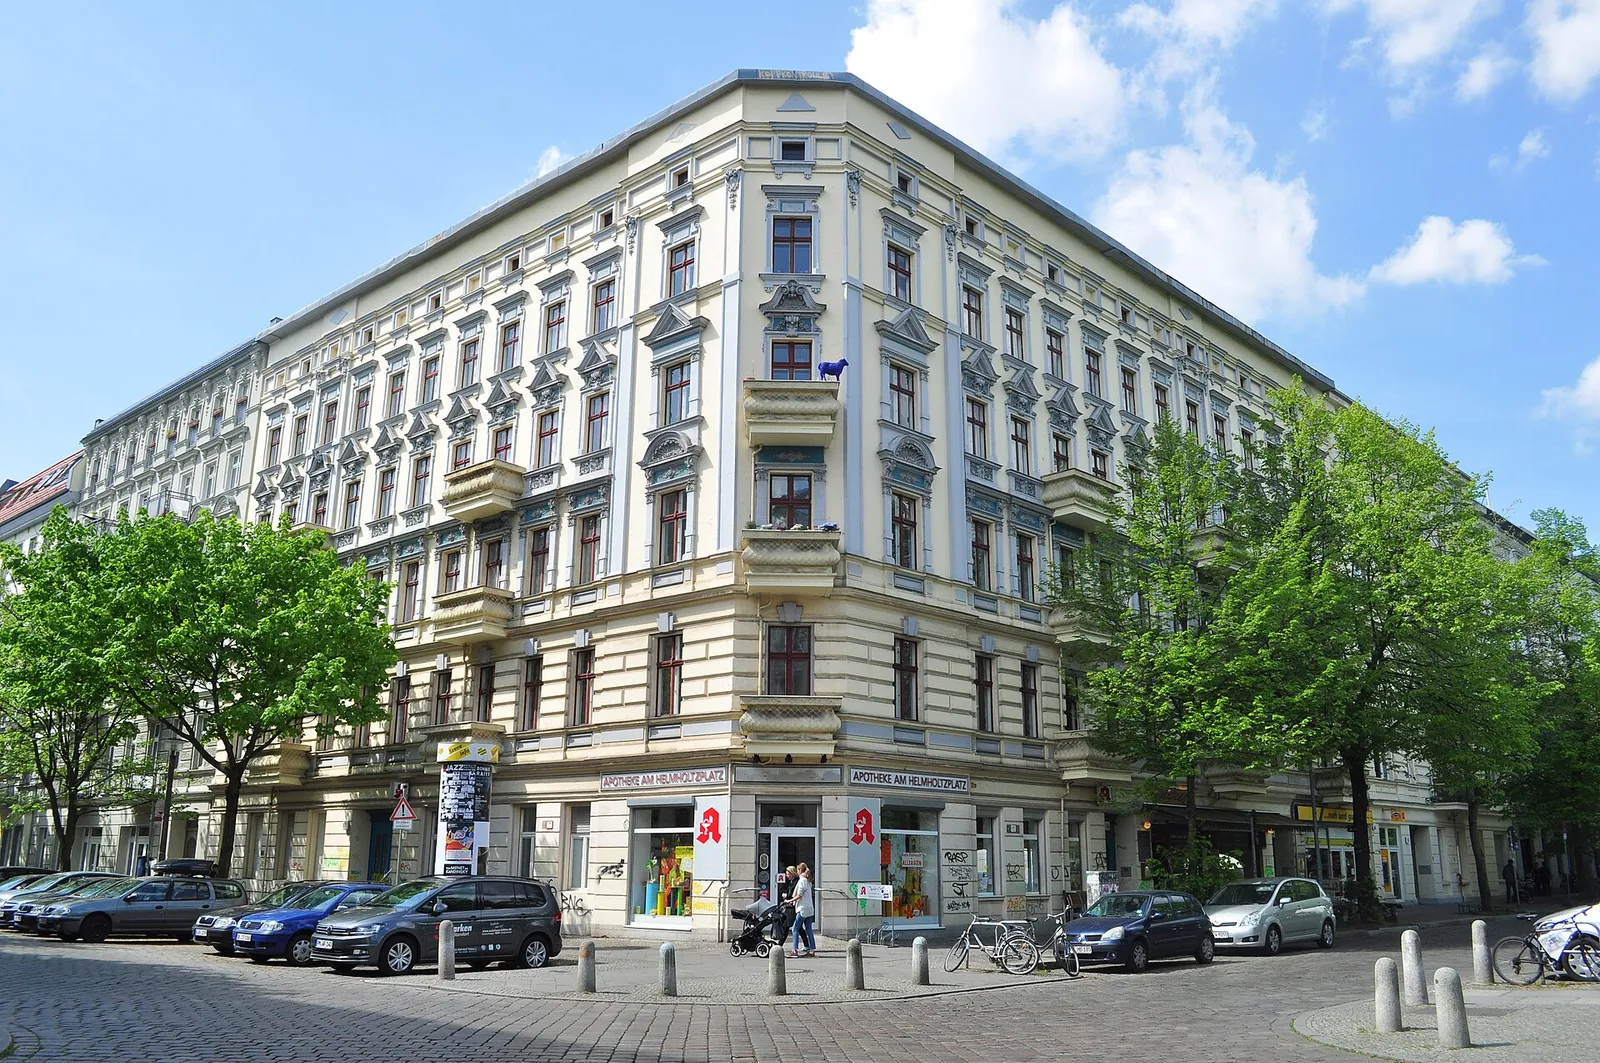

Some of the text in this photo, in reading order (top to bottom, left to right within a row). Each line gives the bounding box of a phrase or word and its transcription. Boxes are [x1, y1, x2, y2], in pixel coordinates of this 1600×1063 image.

[603, 769, 724, 787] APOTHEKE AM HELMHOLTZPLATZ
[852, 771, 967, 790] APOTHEKE AM HELMHOLTZPLATZ
[453, 923, 473, 933] arken
